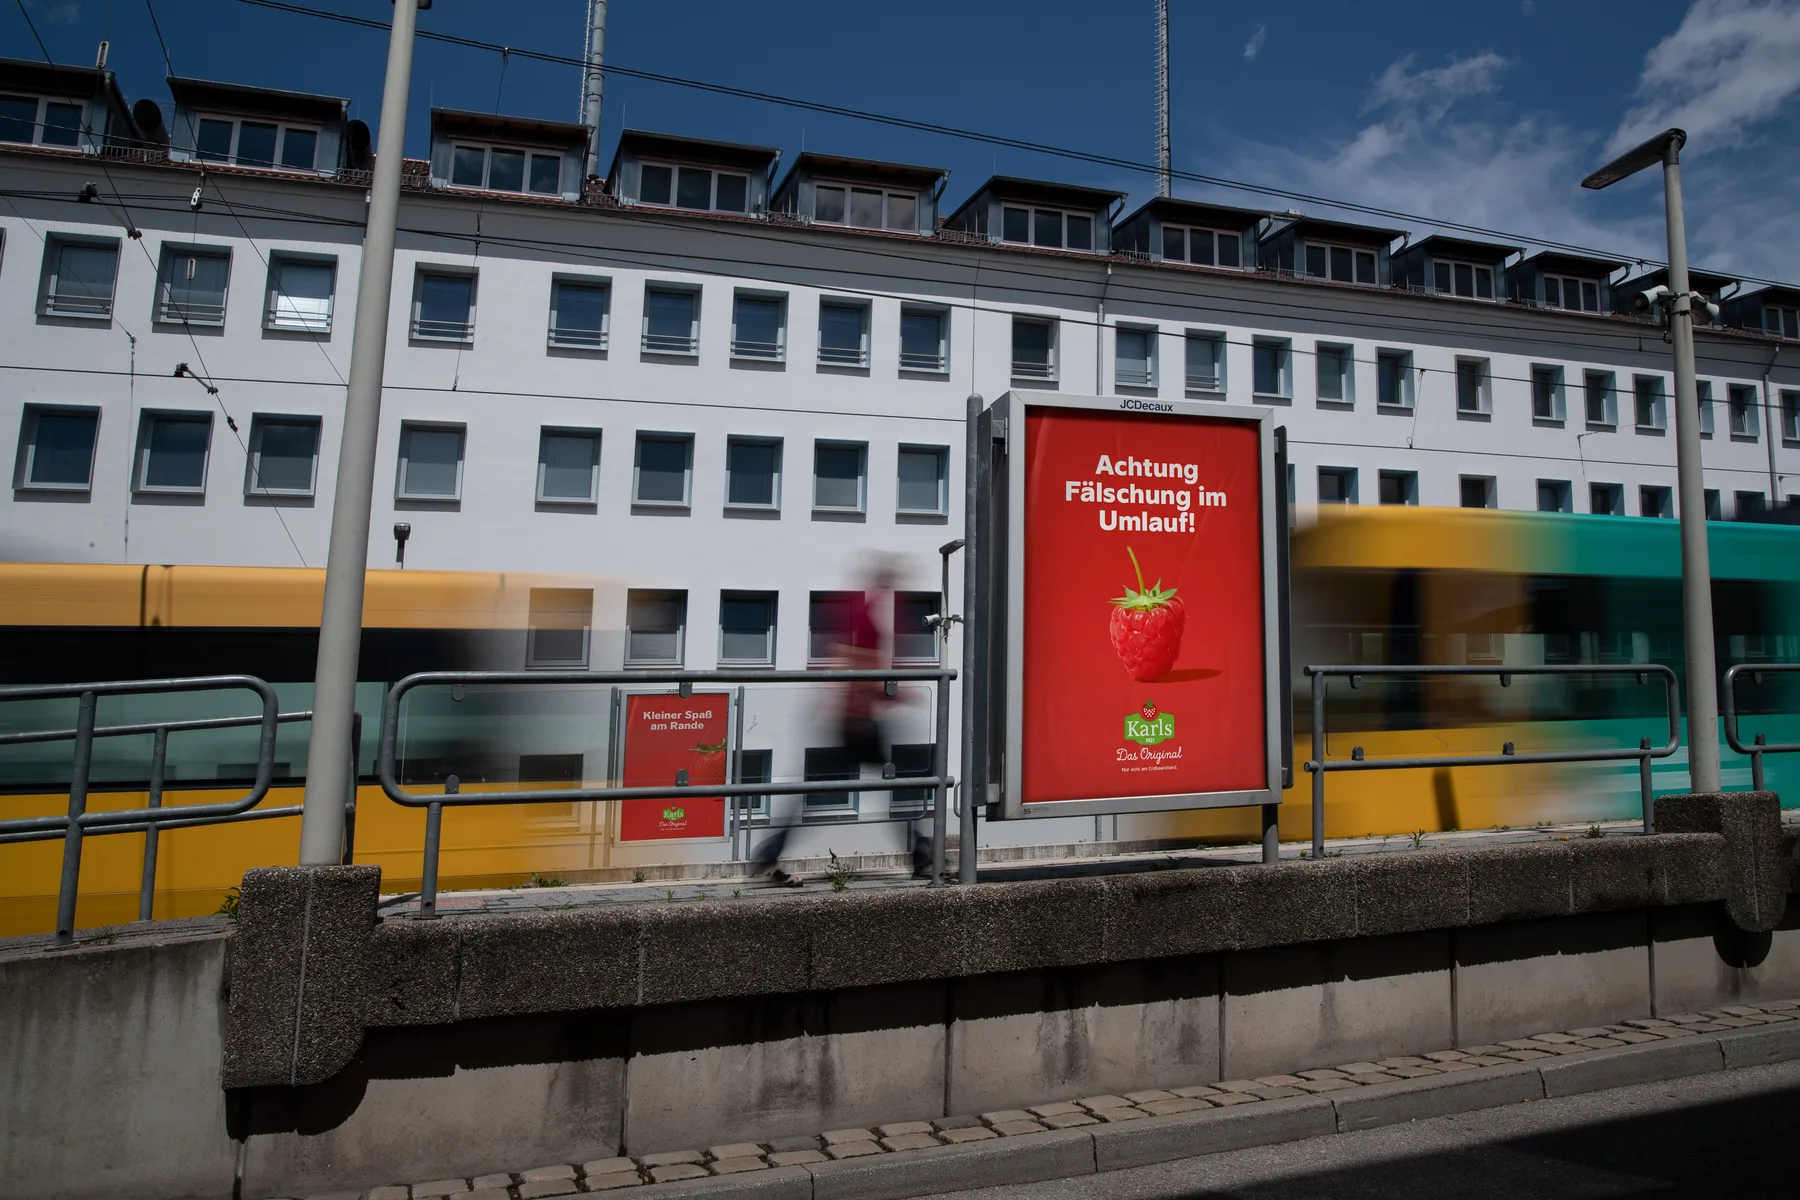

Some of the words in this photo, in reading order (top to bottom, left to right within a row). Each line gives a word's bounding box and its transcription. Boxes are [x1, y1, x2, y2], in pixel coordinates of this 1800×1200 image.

[1120, 399, 1173, 412] JCDecaux
[1095, 454, 1199, 485] Achtung
[1065, 480, 1191, 511] Fälschung
[1198, 485, 1227, 507] im
[1099, 510, 1196, 533] Umlauf!
[643, 711, 682, 720] Kleiner
[684, 710, 713, 721] Spaß
[670, 721, 704, 730] Rande
[1127, 718, 1173, 737] Karls
[1116, 747, 1139, 761] Das
[1140, 745, 1183, 765] Original
[663, 810, 684, 819] Karls
